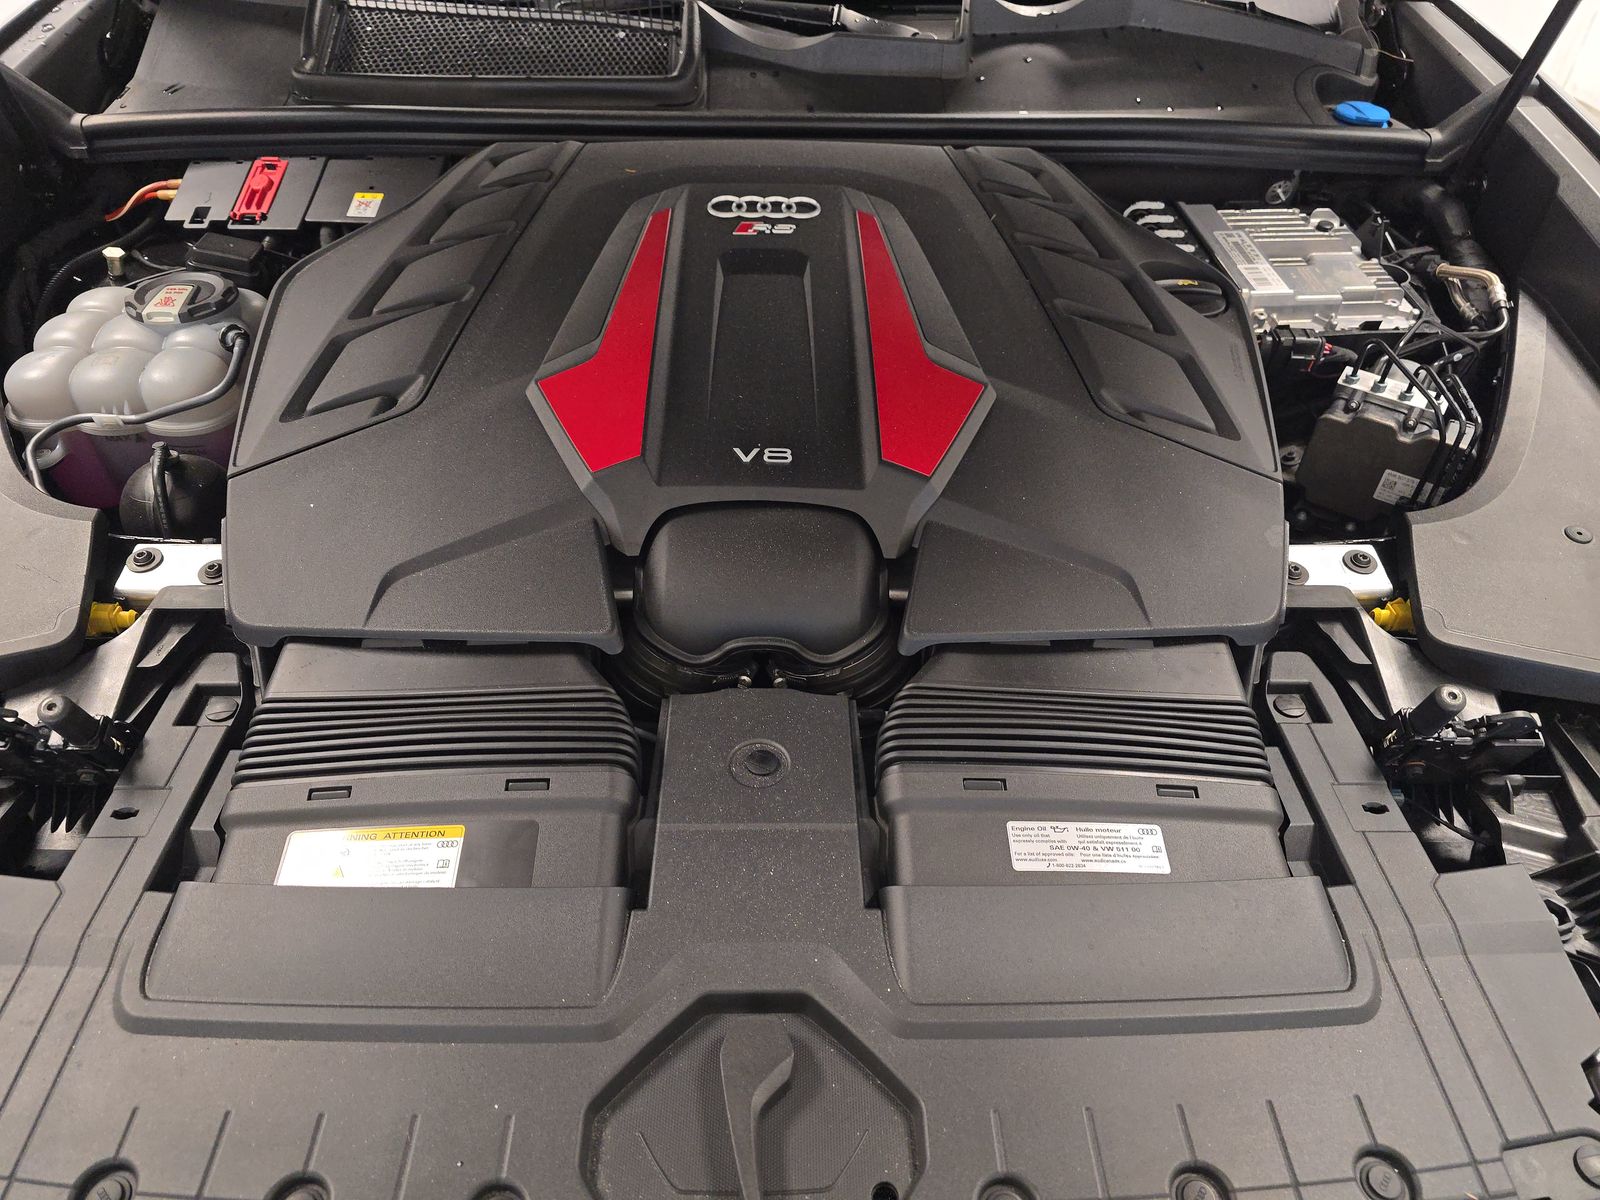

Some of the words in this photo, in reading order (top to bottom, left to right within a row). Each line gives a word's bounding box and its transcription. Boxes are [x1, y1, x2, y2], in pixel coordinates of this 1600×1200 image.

[732, 221, 796, 235] RS
[733, 447, 792, 462] V8
[384, 830, 446, 840] ATTENTION
[1011, 825, 1035, 833] Engine
